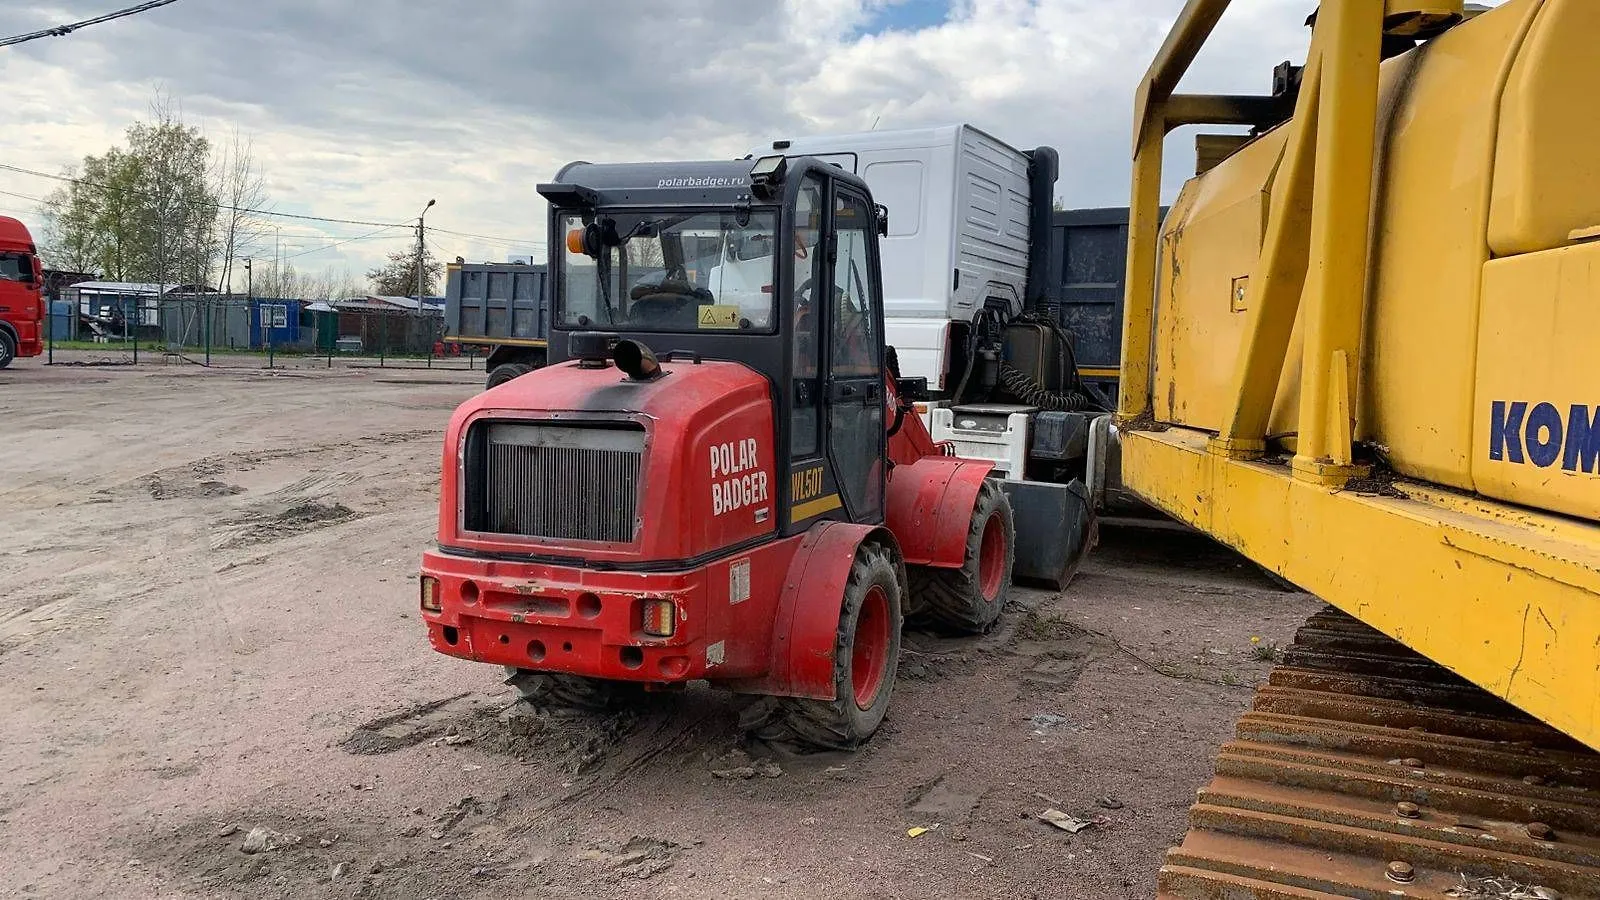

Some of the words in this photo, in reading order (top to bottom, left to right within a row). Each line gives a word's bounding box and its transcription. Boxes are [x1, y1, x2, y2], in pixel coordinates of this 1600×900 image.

[709, 438, 758, 478] POLAR
[1489, 400, 1600, 475] KOM
[712, 471, 768, 516] BADGER
[791, 467, 824, 502] WL50T
